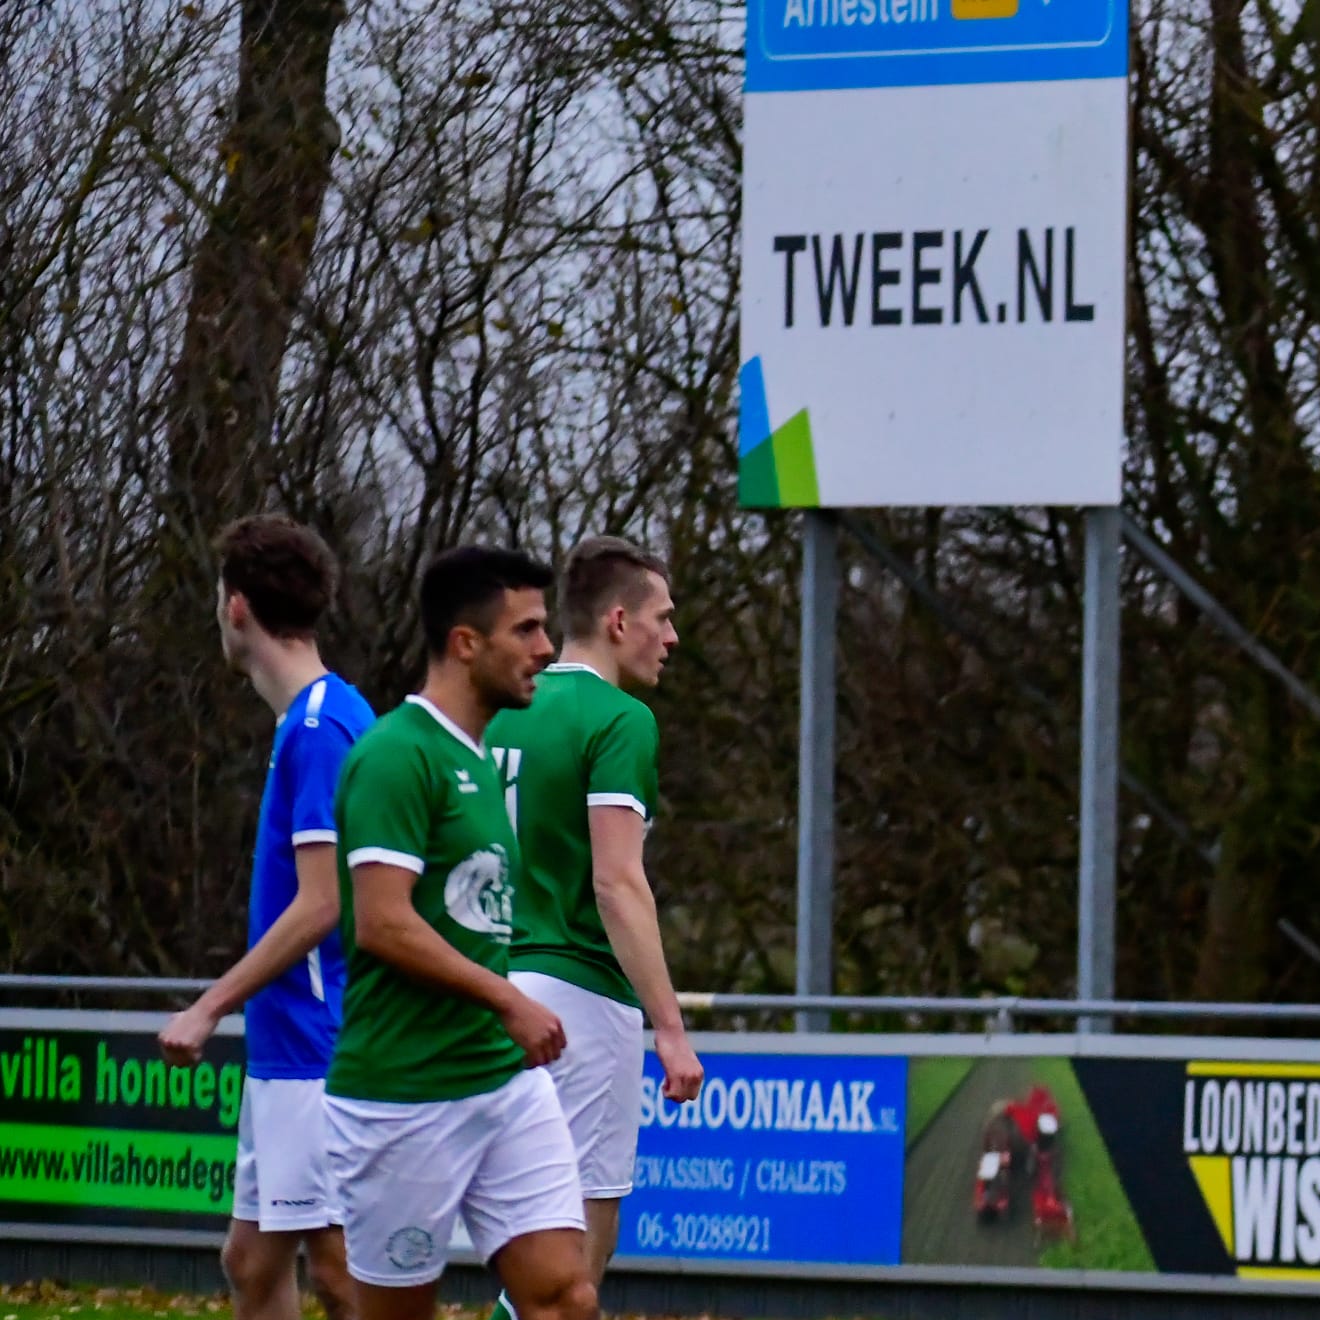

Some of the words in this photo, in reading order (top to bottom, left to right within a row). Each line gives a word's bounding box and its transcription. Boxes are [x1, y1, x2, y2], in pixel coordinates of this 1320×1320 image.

[773, 226, 1095, 328] TWEEK.NL
[0, 1037, 83, 1101] villa
[756, 1160, 846, 1194] CHALETS
